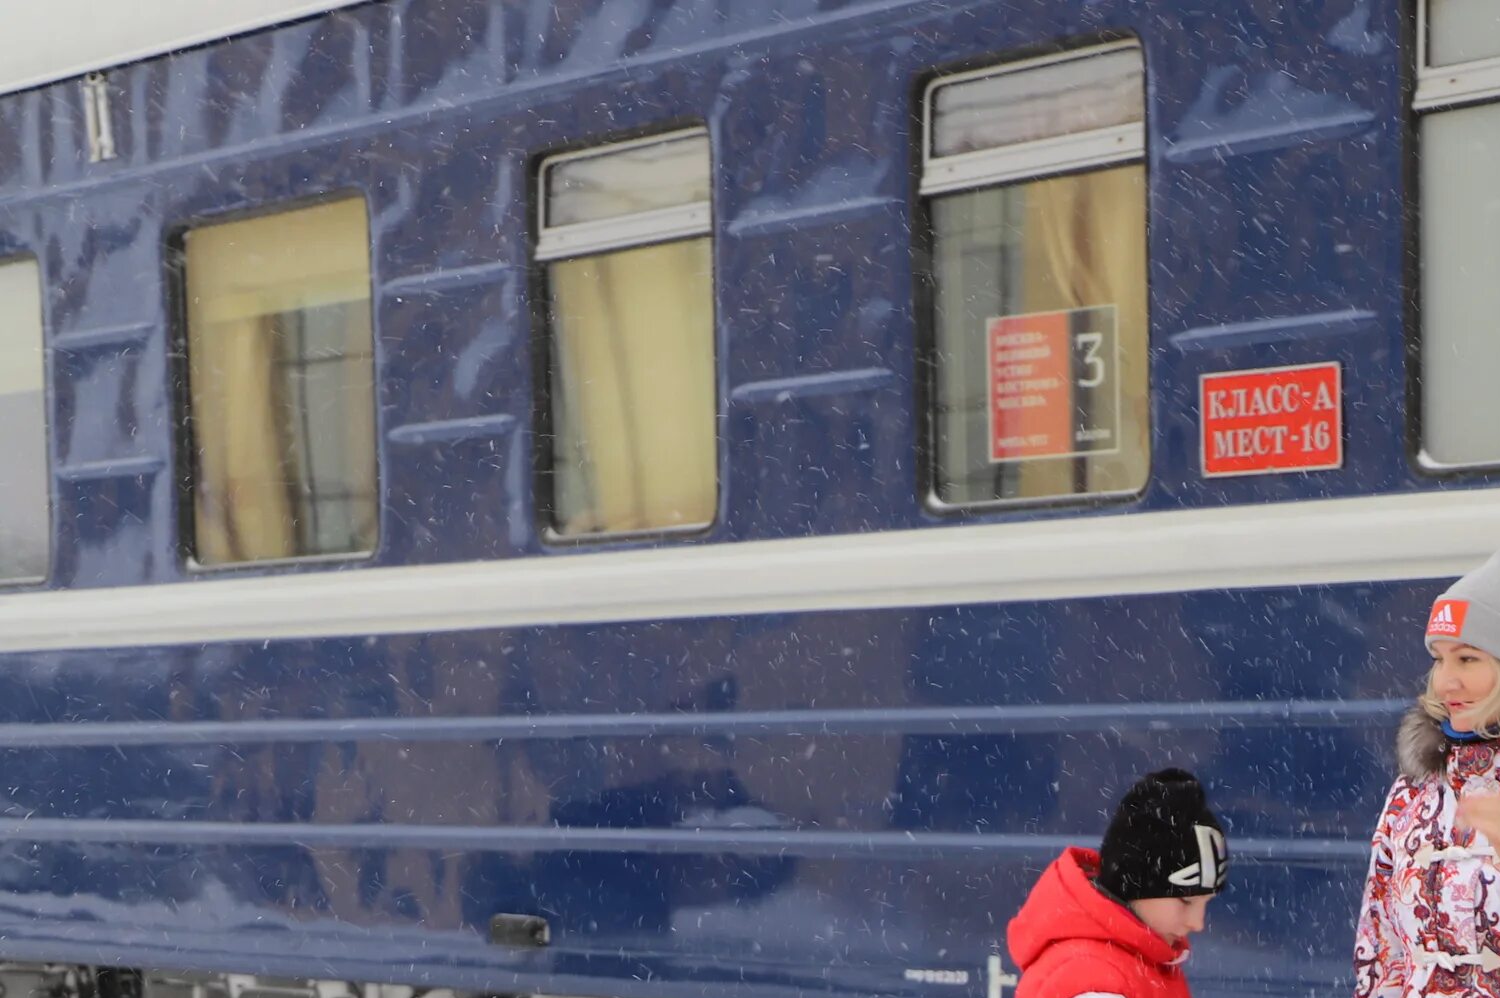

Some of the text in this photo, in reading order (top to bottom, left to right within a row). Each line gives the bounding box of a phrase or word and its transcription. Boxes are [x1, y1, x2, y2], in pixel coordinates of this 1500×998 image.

[1076, 332, 1105, 387] 3
[1207, 381, 1335, 419] КЛАСС-А
[1212, 421, 1331, 459] МЕСТ-16
